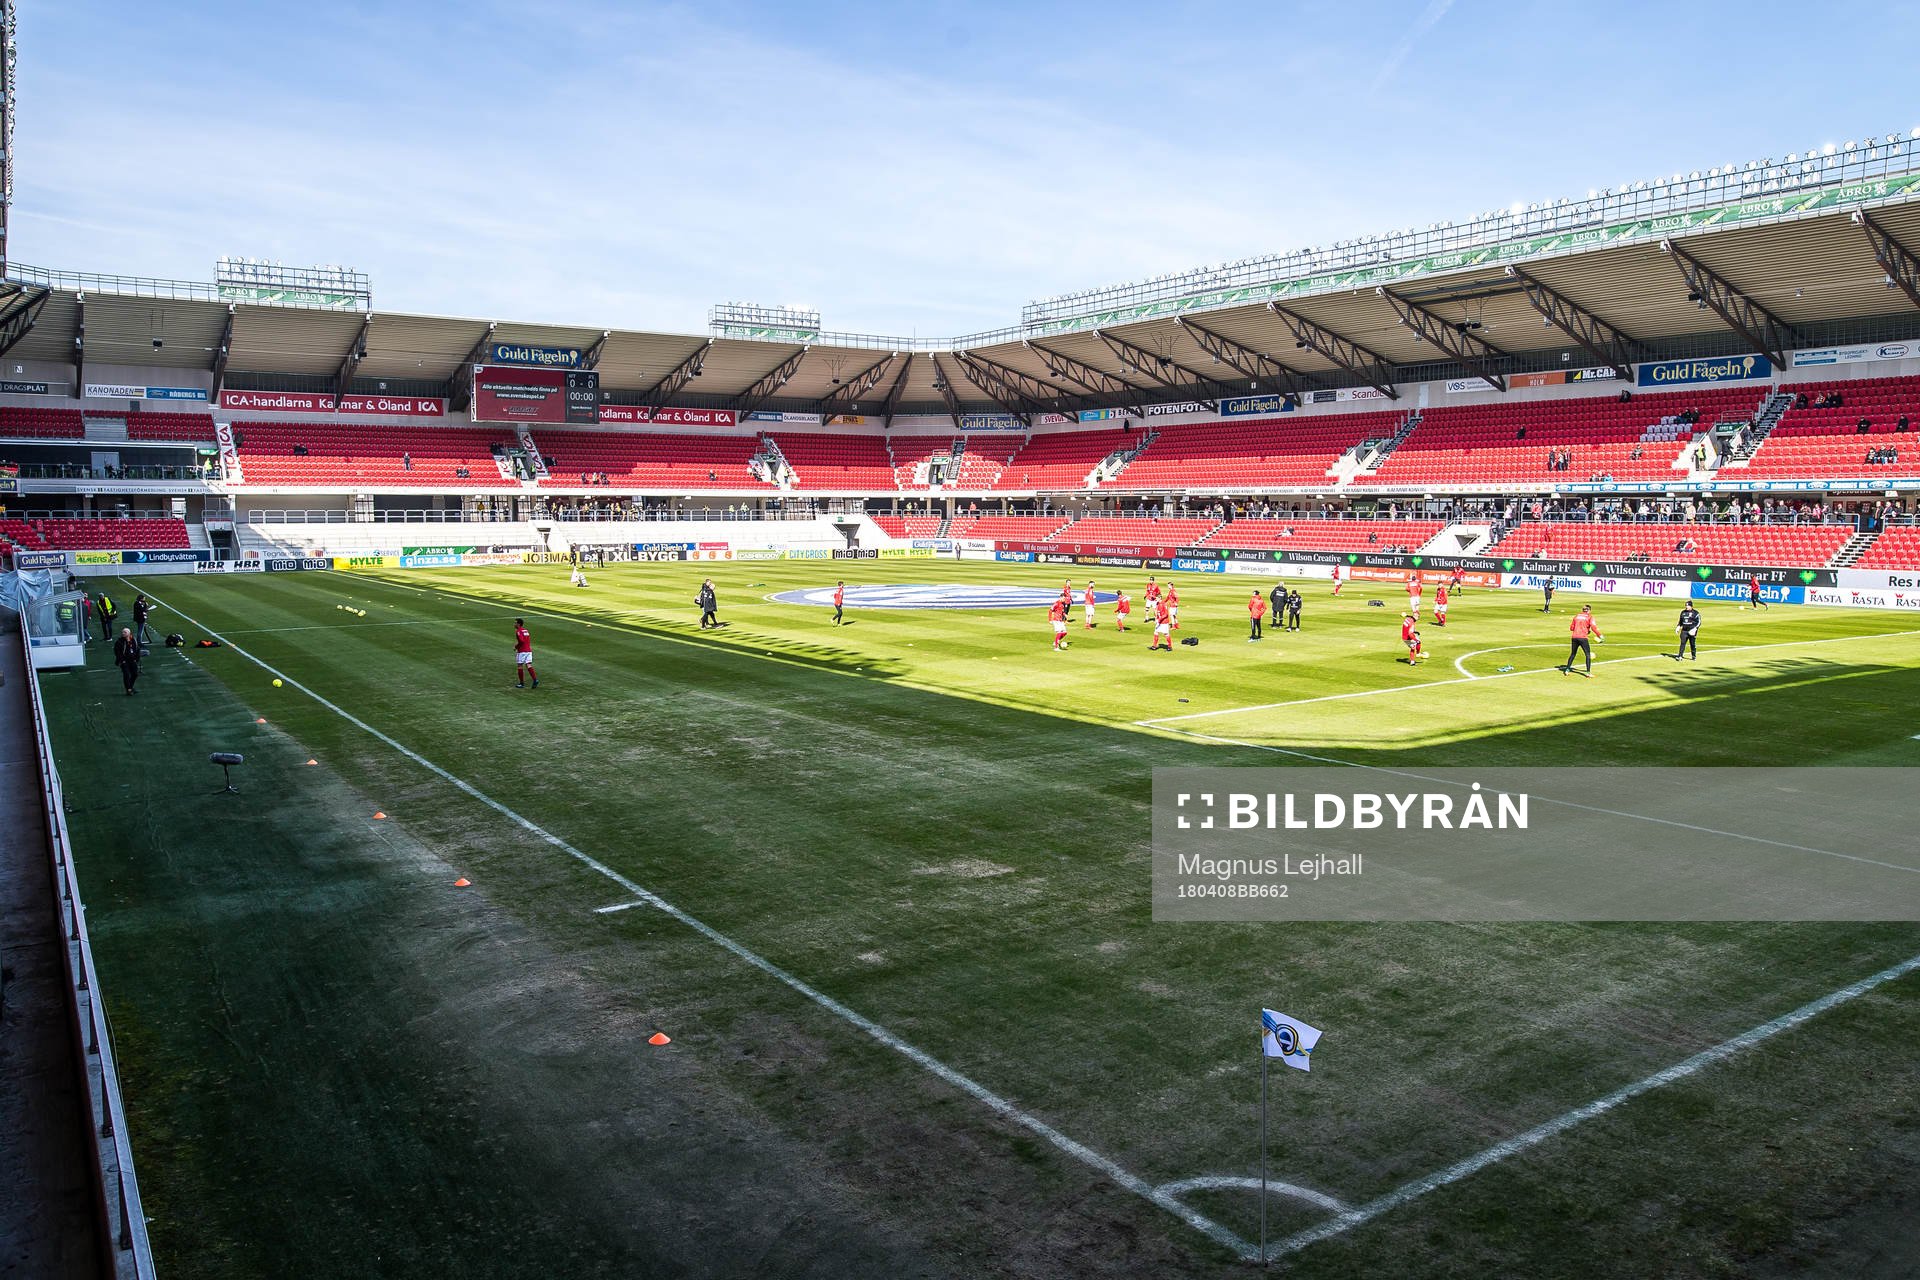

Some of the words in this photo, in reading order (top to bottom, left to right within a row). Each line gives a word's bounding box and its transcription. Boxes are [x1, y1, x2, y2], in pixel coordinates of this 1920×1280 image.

[498, 346, 529, 361] Guld
[530, 349, 570, 365] Fågeln
[1653, 363, 1689, 381] Guld
[1691, 360, 1741, 381] Fågeln
[226, 395, 313, 409] ICA-handlarna
[319, 398, 364, 410] Kamar
[366, 400, 375, 410] &
[378, 397, 412, 412] Öland
[418, 401, 439, 412] ICA
[1229, 401, 1250, 413] Guld
[1251, 398, 1279, 413] Fågeln
[1148, 404, 1180, 415] FOTEN
[637, 411, 672, 421] Kamar
[674, 413, 682, 421] &
[684, 411, 710, 423] Öland
[715, 413, 732, 423] ICA
[960, 417, 986, 429] Guld
[987, 416, 1020, 431] Fågeln
[149, 552, 197, 562] Lindbytvätten
[524, 553, 579, 564] JOBMA
[1175, 548, 1192, 556] ilson
[1193, 549, 1217, 558] Creative
[1234, 551, 1257, 560] Kalmar
[1258, 551, 1267, 560] FF
[1289, 552, 1312, 562] Wilson
[1313, 553, 1342, 563] Creative
[21, 554, 40, 566] Guld
[198, 561, 225, 569] HBR
[234, 560, 260, 568] HBR
[349, 557, 384, 566] HYLTE
[1178, 559, 1195, 569] Guld
[1365, 556, 1393, 566] Kalmar
[1394, 557, 1405, 566] FF
[1430, 558, 1459, 568] Wilson
[1460, 559, 1495, 569] Creative
[1522, 562, 1558, 572] Kalmar
[1559, 562, 1571, 573] FF
[1605, 564, 1642, 575] Wilson
[1643, 566, 1687, 577] Creative
[1771, 571, 1787, 581] FF
[1528, 576, 1582, 590] Myrsjöhus
[1888, 576, 1913, 588] Res
[1703, 583, 1735, 598] Guld
[1737, 585, 1780, 600] Fåeln
[1810, 593, 1842, 604] RASTA
[1852, 595, 1885, 605] RASTA
